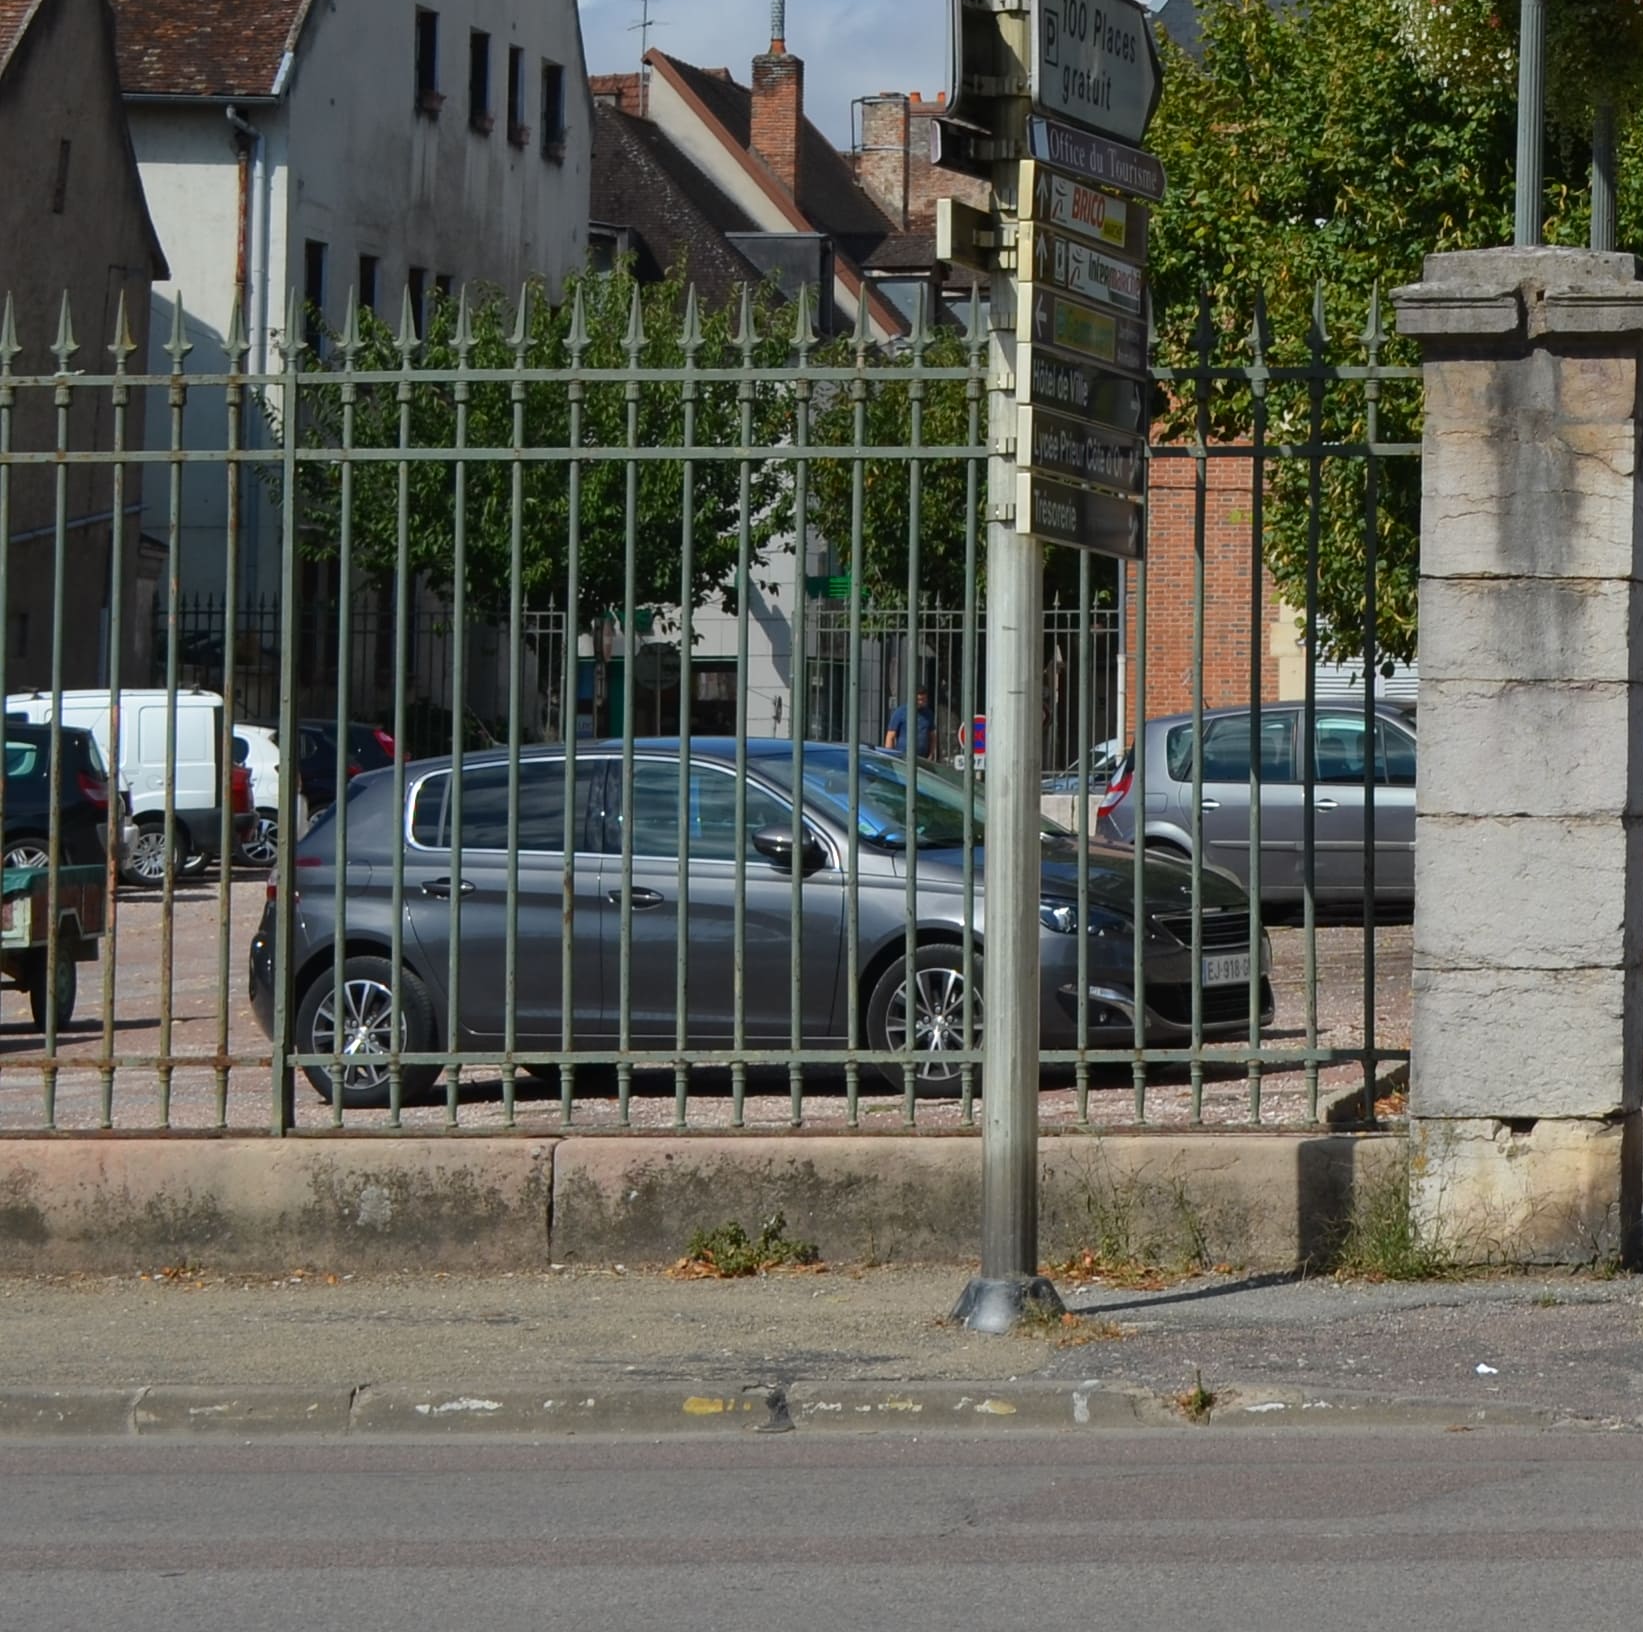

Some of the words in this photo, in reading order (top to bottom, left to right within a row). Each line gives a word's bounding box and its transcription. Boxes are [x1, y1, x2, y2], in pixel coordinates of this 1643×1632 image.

[1046, 14, 1056, 57] P
[1093, 8, 1136, 64] Places
[1062, 66, 1112, 111] gratuit
[1049, 128, 1086, 168] Office
[1090, 143, 1104, 173] du
[1107, 148, 1157, 191] Tourisme
[1072, 187, 1105, 229] BRICO
[1033, 359, 1056, 398] Hôtel
[1057, 367, 1069, 400] de
[1070, 369, 1089, 407] Ville
[1033, 423, 1058, 464] Lycée
[1033, 489, 1077, 532] Trésorerie
